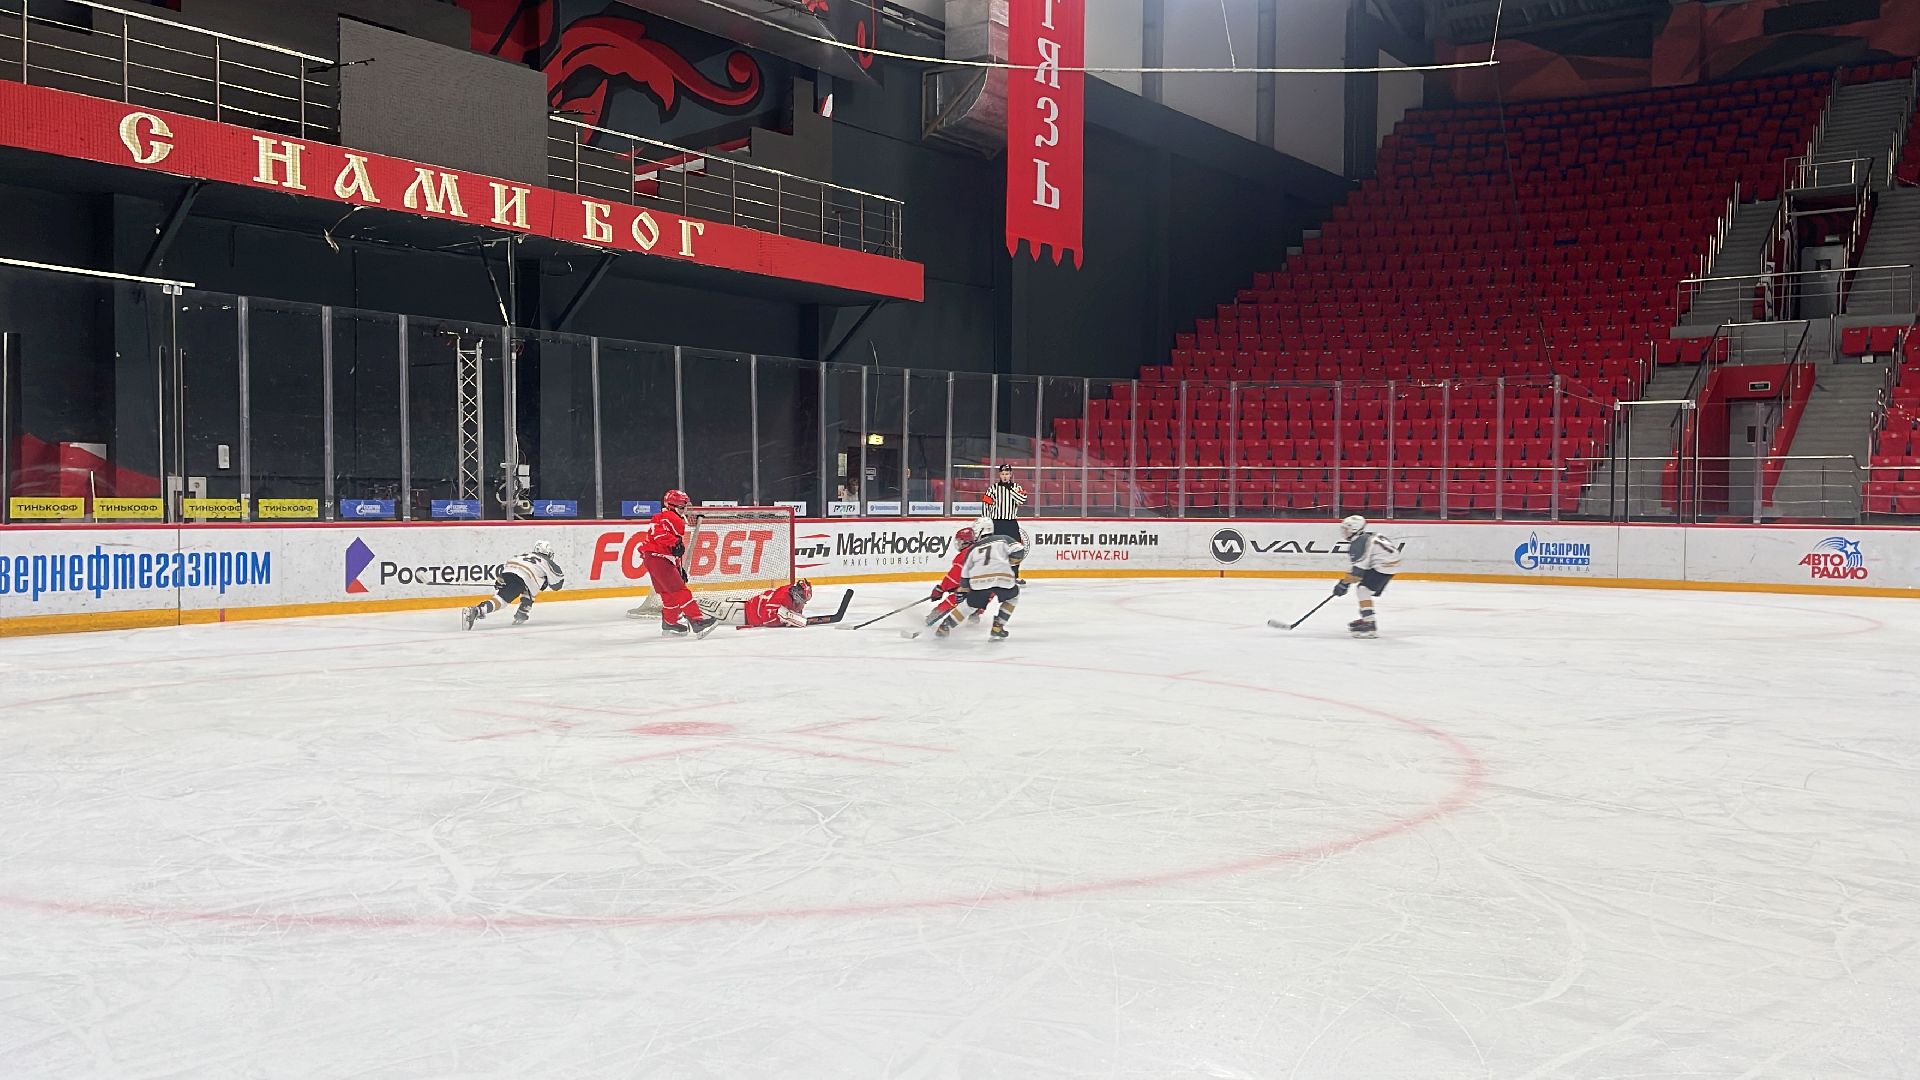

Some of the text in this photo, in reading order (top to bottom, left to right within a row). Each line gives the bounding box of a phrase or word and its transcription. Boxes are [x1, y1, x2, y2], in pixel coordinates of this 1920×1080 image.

[119, 111, 705, 258] С НАМИ БОГ
[17, 504, 78, 512] ТИНЬКОФФ
[100, 504, 158, 512] ТИНЬКОФФ
[1035, 533, 1094, 545] БИЛЕТЫ
[1098, 530, 1159, 546] ОНЛАЙН
[836, 531, 953, 559] MarkHockey
[1540, 543, 1591, 556] ГАЗПРОМ
[590, 530, 773, 581] FOBET
[843, 555, 930, 567] MAKE YOURSELF
[978, 545, 992, 566] 7
[1056, 550, 1129, 561] HCVITYAZ.RU
[1540, 557, 1589, 565] ТРАНСГАЗ
[1798, 553, 1844, 566] АВТО
[1811, 566, 1868, 580] РАДИО
